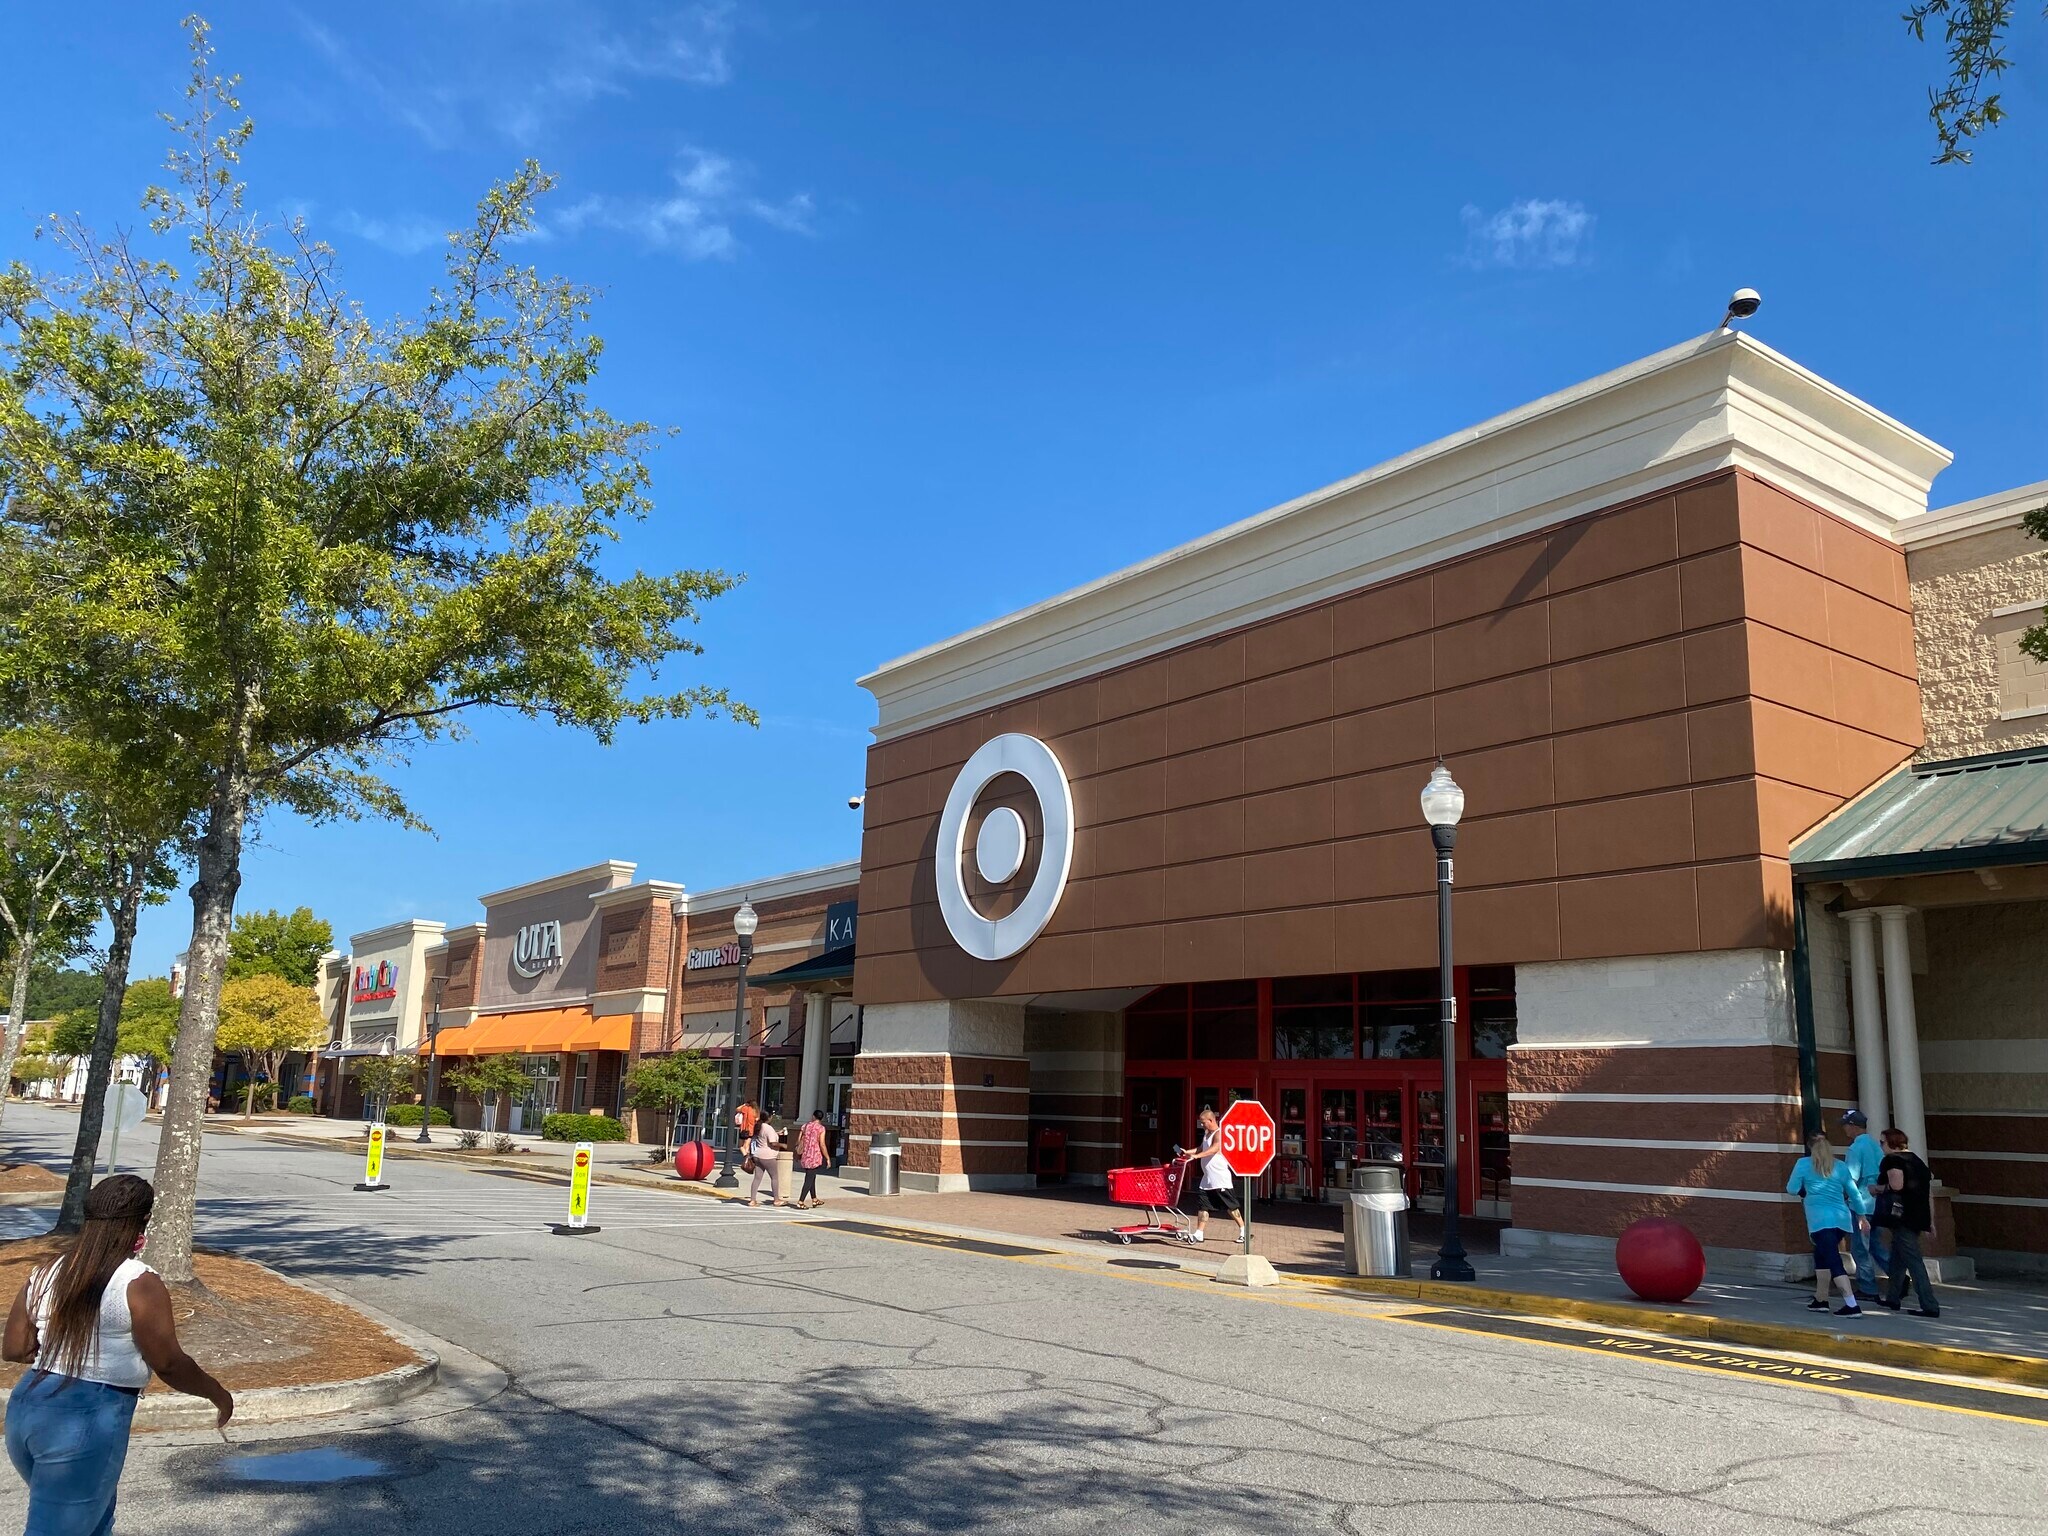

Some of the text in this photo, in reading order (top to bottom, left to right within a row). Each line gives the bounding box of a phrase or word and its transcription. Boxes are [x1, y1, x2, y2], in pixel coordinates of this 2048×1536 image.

[518, 919, 562, 963] ULTA
[687, 942, 744, 971] GameSto
[355, 960, 399, 991] Party City
[1224, 1124, 1272, 1153] STOP
[1587, 1338, 1852, 1381] NO PARKING
